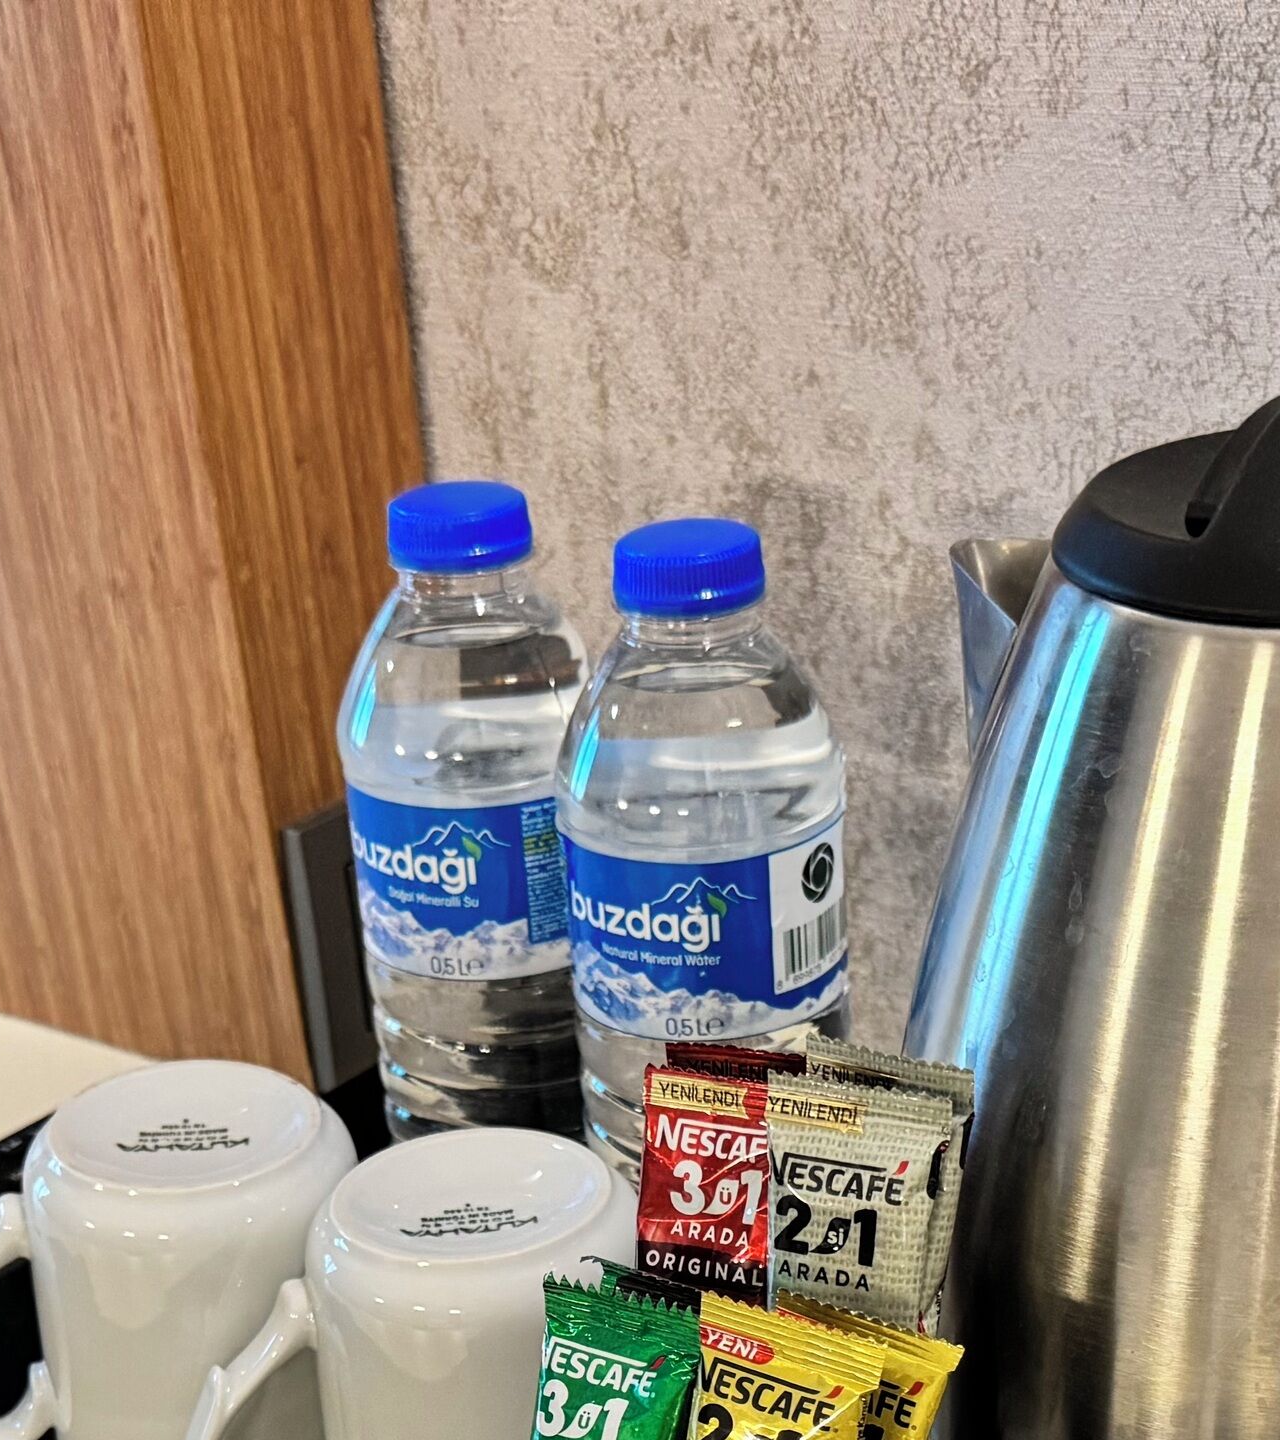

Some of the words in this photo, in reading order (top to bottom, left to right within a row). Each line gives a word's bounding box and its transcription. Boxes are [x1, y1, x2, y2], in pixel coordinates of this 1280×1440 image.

[570, 880, 721, 952] buzdağı
[601, 942, 638, 961] Natural
[640, 951, 683, 967] Mineral
[685, 954, 721, 967] Water
[665, 1018, 694, 1038] 0,5
[658, 1081, 741, 1108] YENİLENDİ
[768, 1094, 859, 1126] YENİLENDİ
[654, 1114, 767, 1163] NESCAF
[670, 1220, 750, 1248] ARADA
[644, 1248, 765, 1288] ORIGINAL
[778, 1259, 871, 1293] ARADA
[705, 1327, 759, 1361] YENİ
